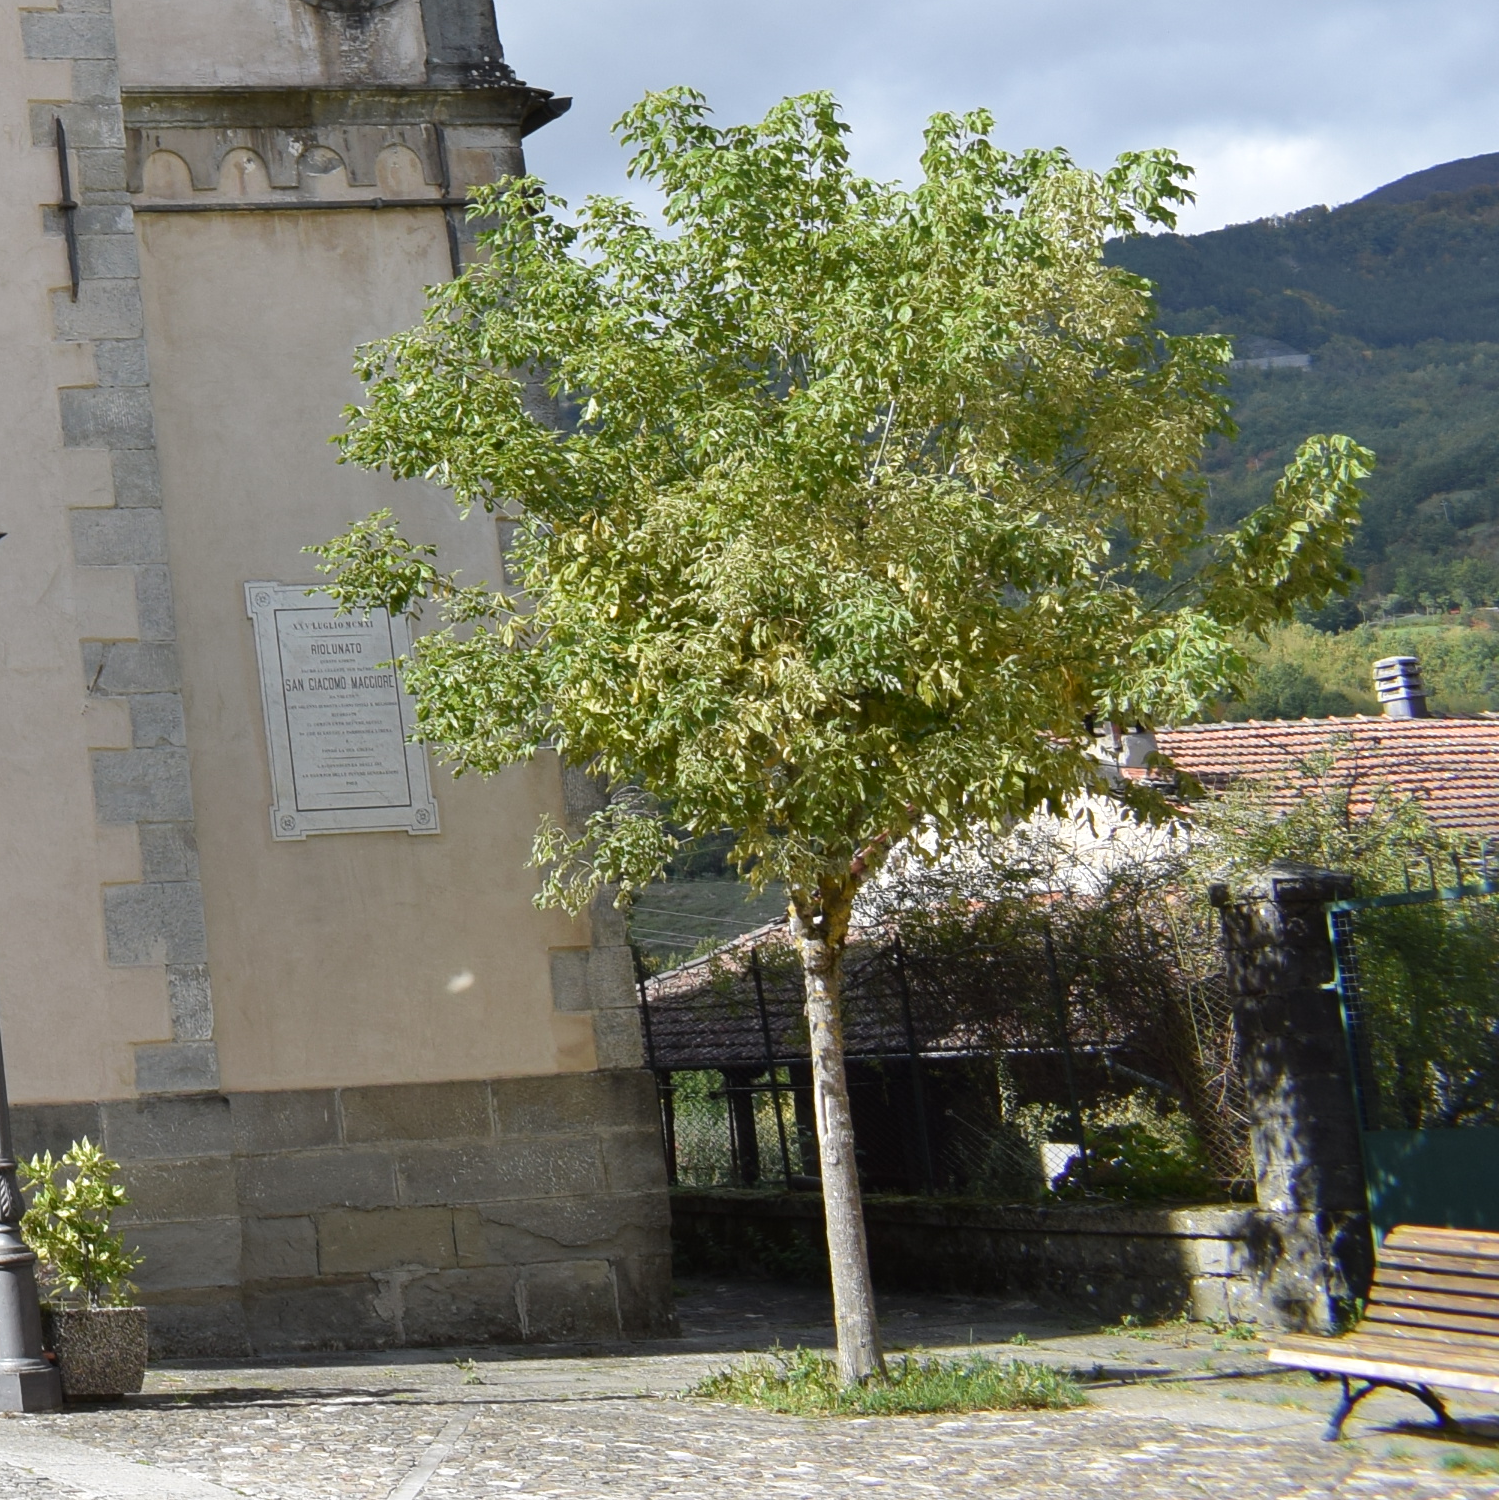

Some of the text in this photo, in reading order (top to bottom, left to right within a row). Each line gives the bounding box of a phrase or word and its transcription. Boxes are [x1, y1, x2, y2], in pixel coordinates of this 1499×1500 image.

[312, 621, 345, 630] LUGLIO
[345, 620, 374, 628] MCMXI
[311, 642, 362, 655] RIOLUNATO
[285, 678, 305, 692] SAN
[308, 676, 347, 691] GIACOMO
